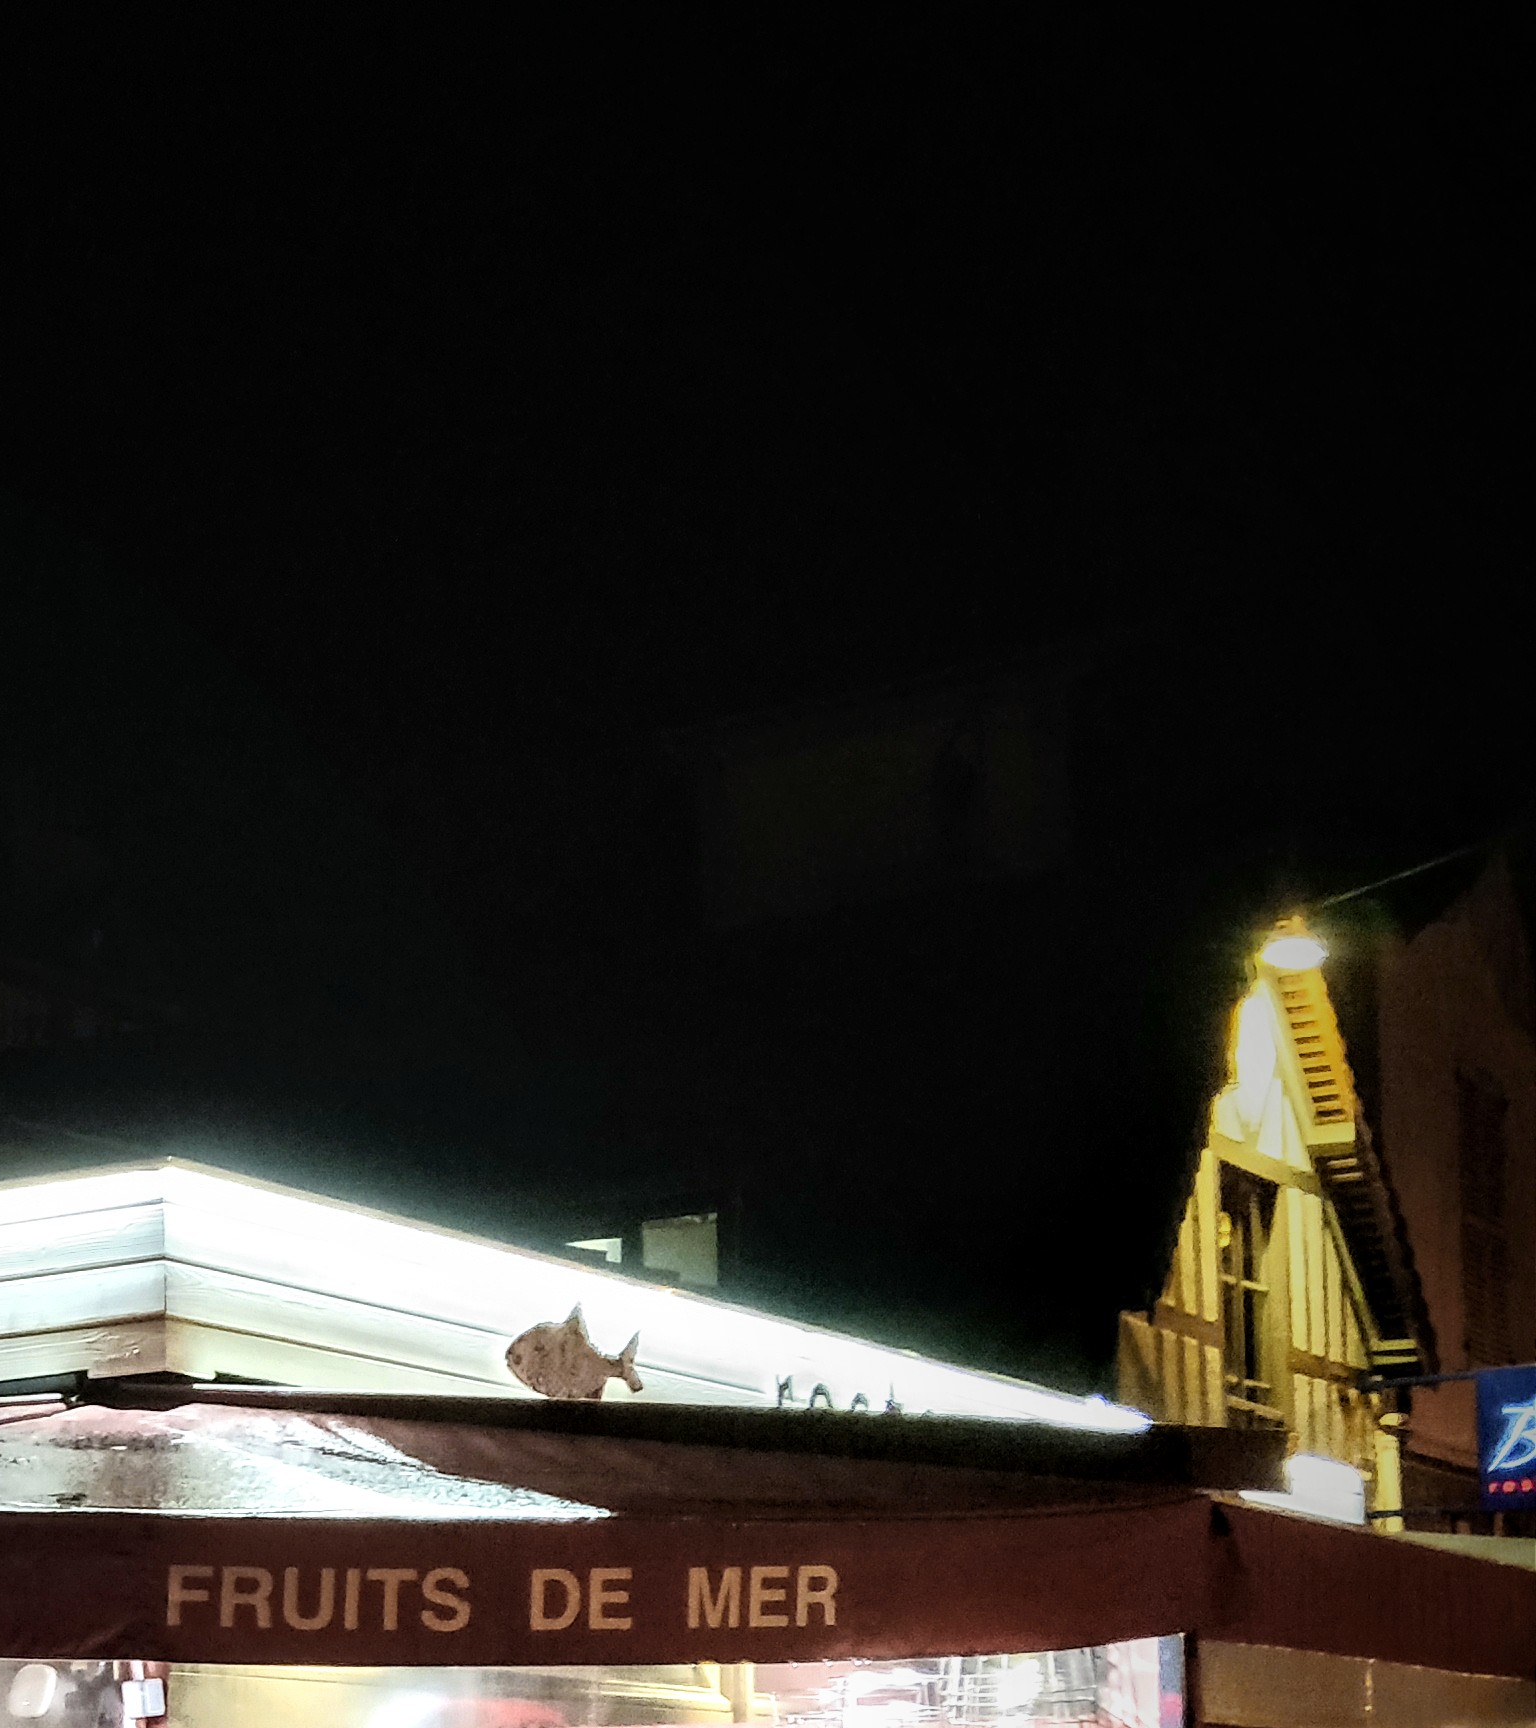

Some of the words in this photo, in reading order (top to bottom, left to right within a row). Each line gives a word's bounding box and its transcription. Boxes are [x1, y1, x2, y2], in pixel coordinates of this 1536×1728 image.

[164, 1563, 472, 1632] FRUITS
[527, 1566, 633, 1632] DE
[685, 1563, 840, 1629] MER
